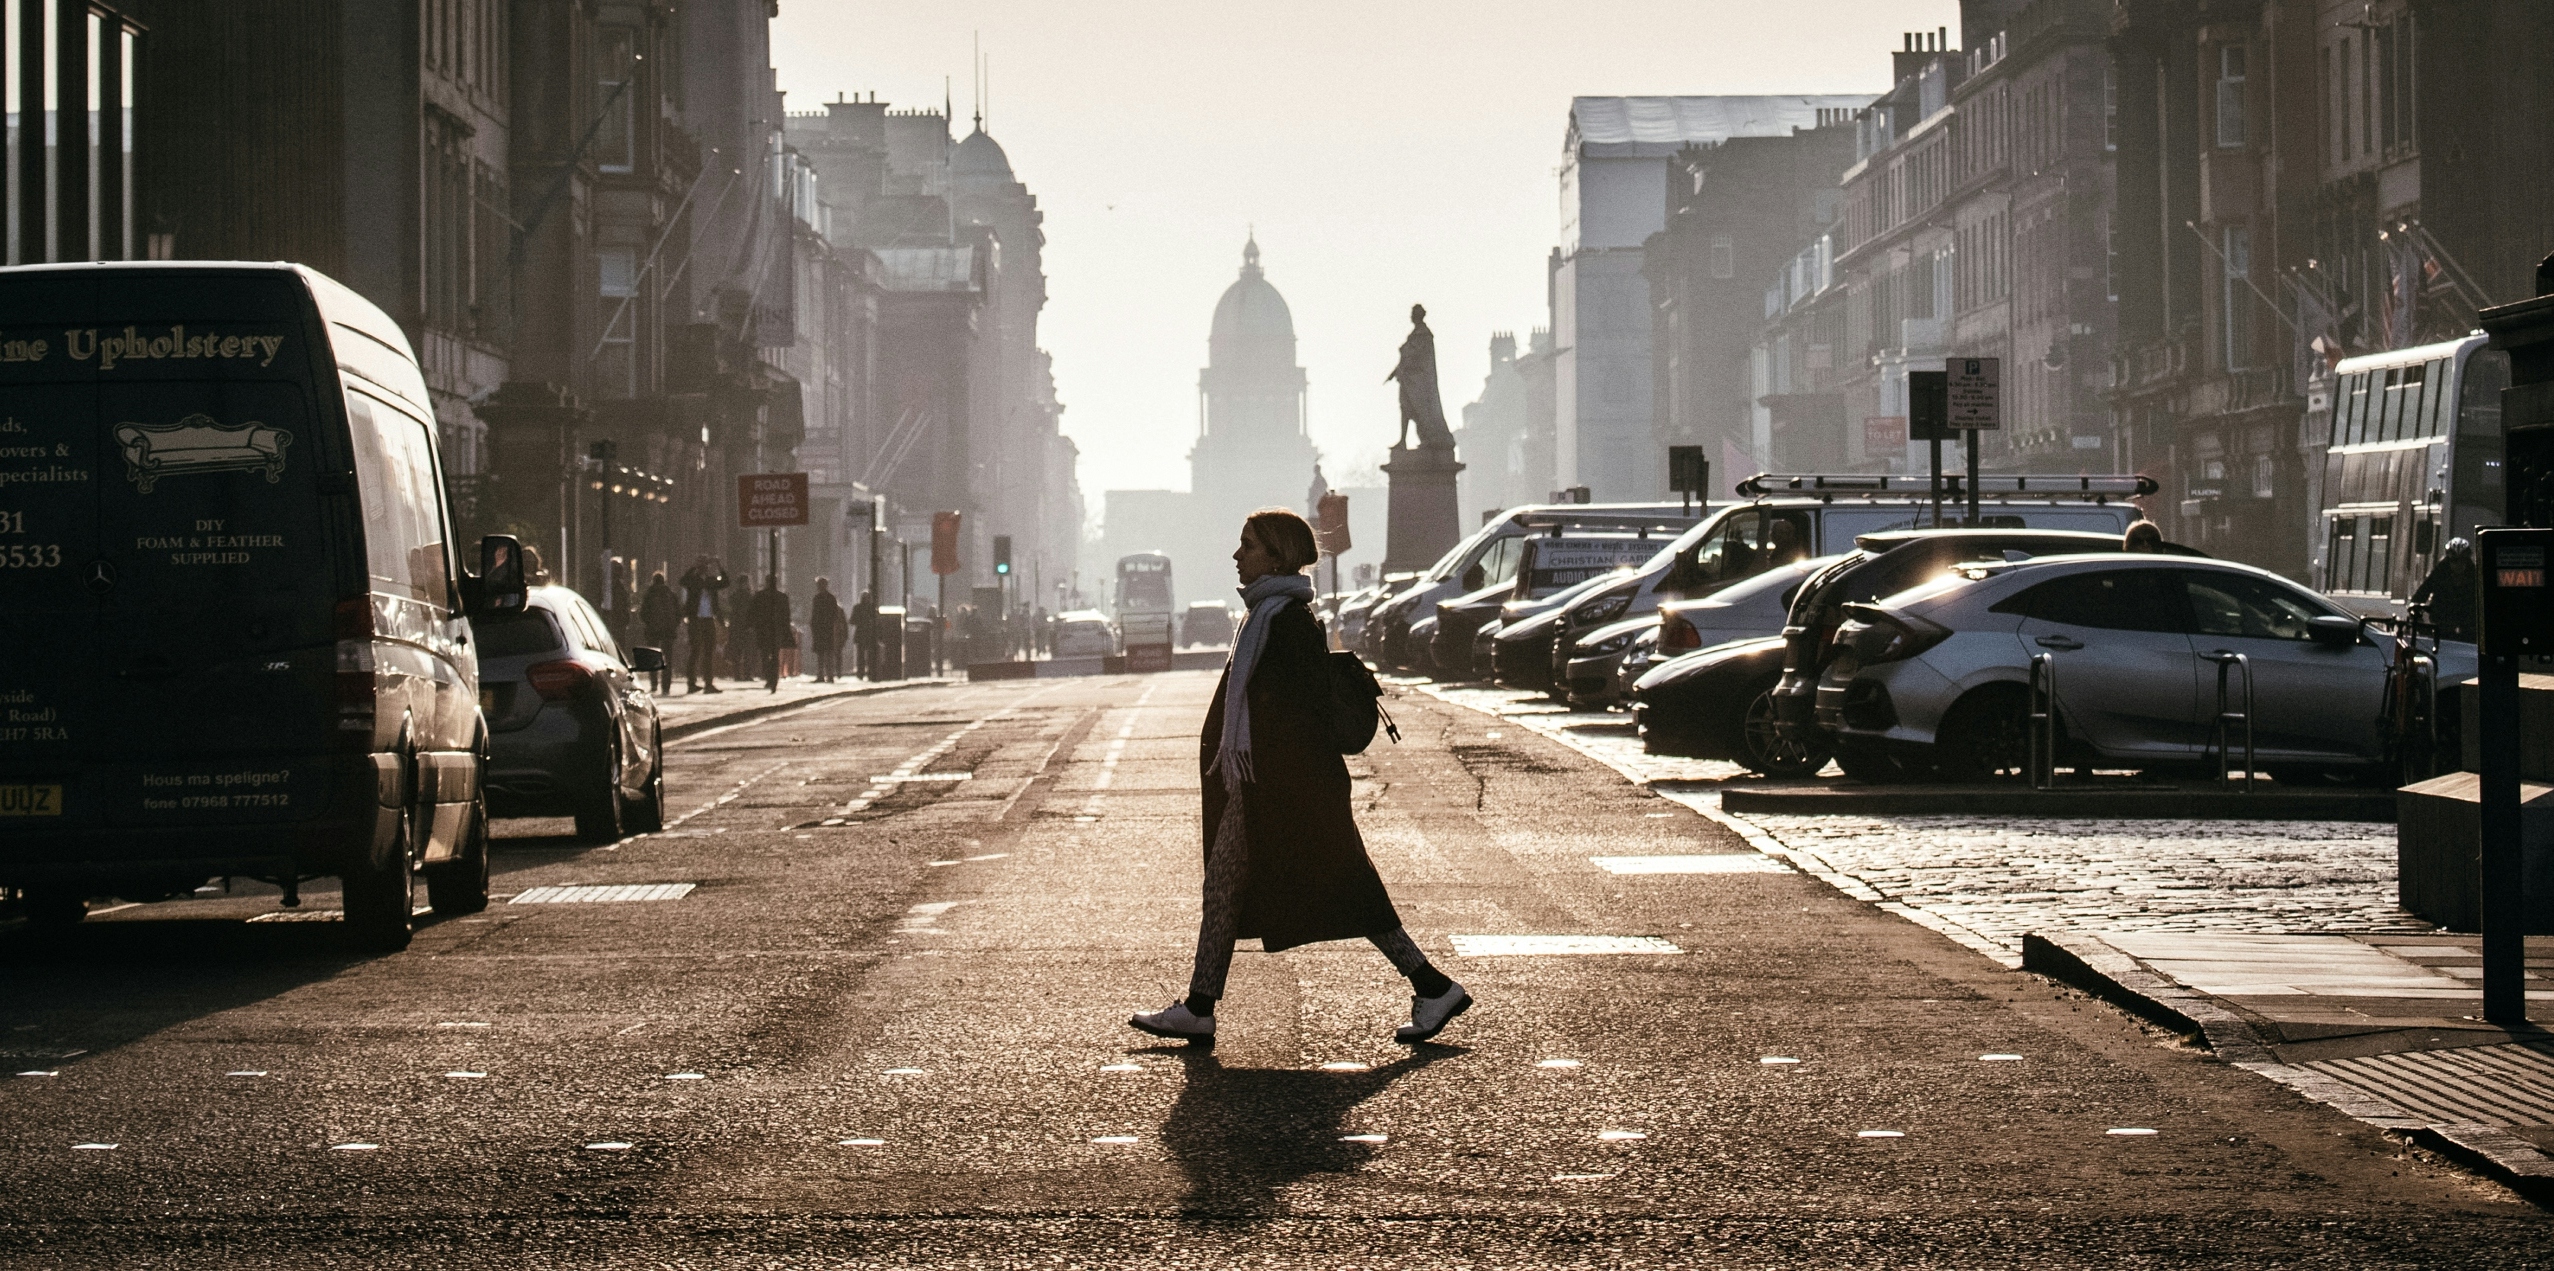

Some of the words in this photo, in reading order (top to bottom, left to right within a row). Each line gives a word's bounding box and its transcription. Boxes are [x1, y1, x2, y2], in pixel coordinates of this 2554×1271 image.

[0, 331, 48, 361] ne
[65, 324, 284, 370] Upholstery
[1868, 431, 1882, 439] TO
[1883, 430, 1902, 439] LET
[55, 442, 70, 457] &
[755, 479, 791, 491] ROAD
[751, 493, 795, 505] AHEAD
[748, 507, 799, 520] CLOSED
[195, 519, 225, 532] DIY
[136, 537, 185, 549] FOAM
[189, 537, 201, 549] &
[206, 535, 285, 548] FEATHER
[171, 552, 251, 565] SUPPLIED
[1550, 556, 1613, 566] CHRISTIAN
[1552, 571, 1585, 583] AUDIO
[2499, 570, 2543, 587] WAIT
[261, 661, 291, 671] 315
[8, 707, 57, 723] Road)
[33, 727, 69, 741] 5RA
[143, 774, 183, 787] Hous
[187, 775, 211, 785] ma
[143, 797, 177, 809] fone
[181, 796, 229, 808] 07968
[232, 794, 289, 807] 777512
